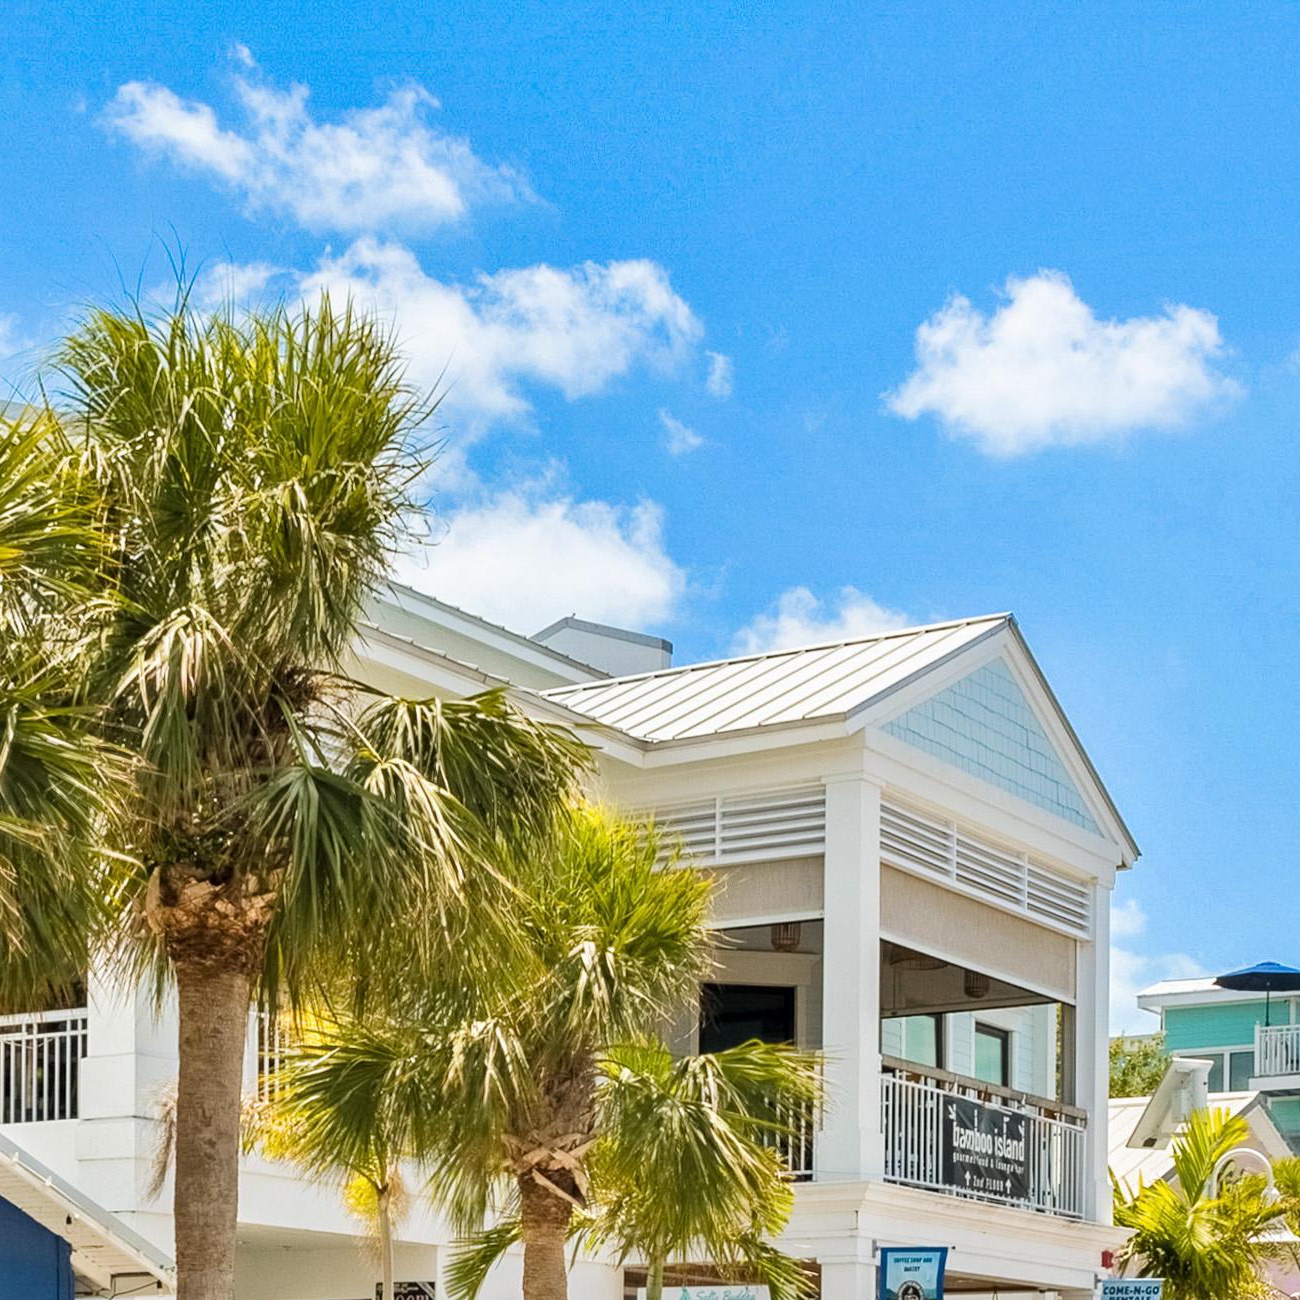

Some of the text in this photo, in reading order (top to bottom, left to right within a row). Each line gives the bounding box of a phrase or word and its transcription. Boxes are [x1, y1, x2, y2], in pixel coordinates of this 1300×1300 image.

[952, 1110, 1025, 1162] bamboo island
[1103, 1286, 1160, 1295] COME-N-GO
